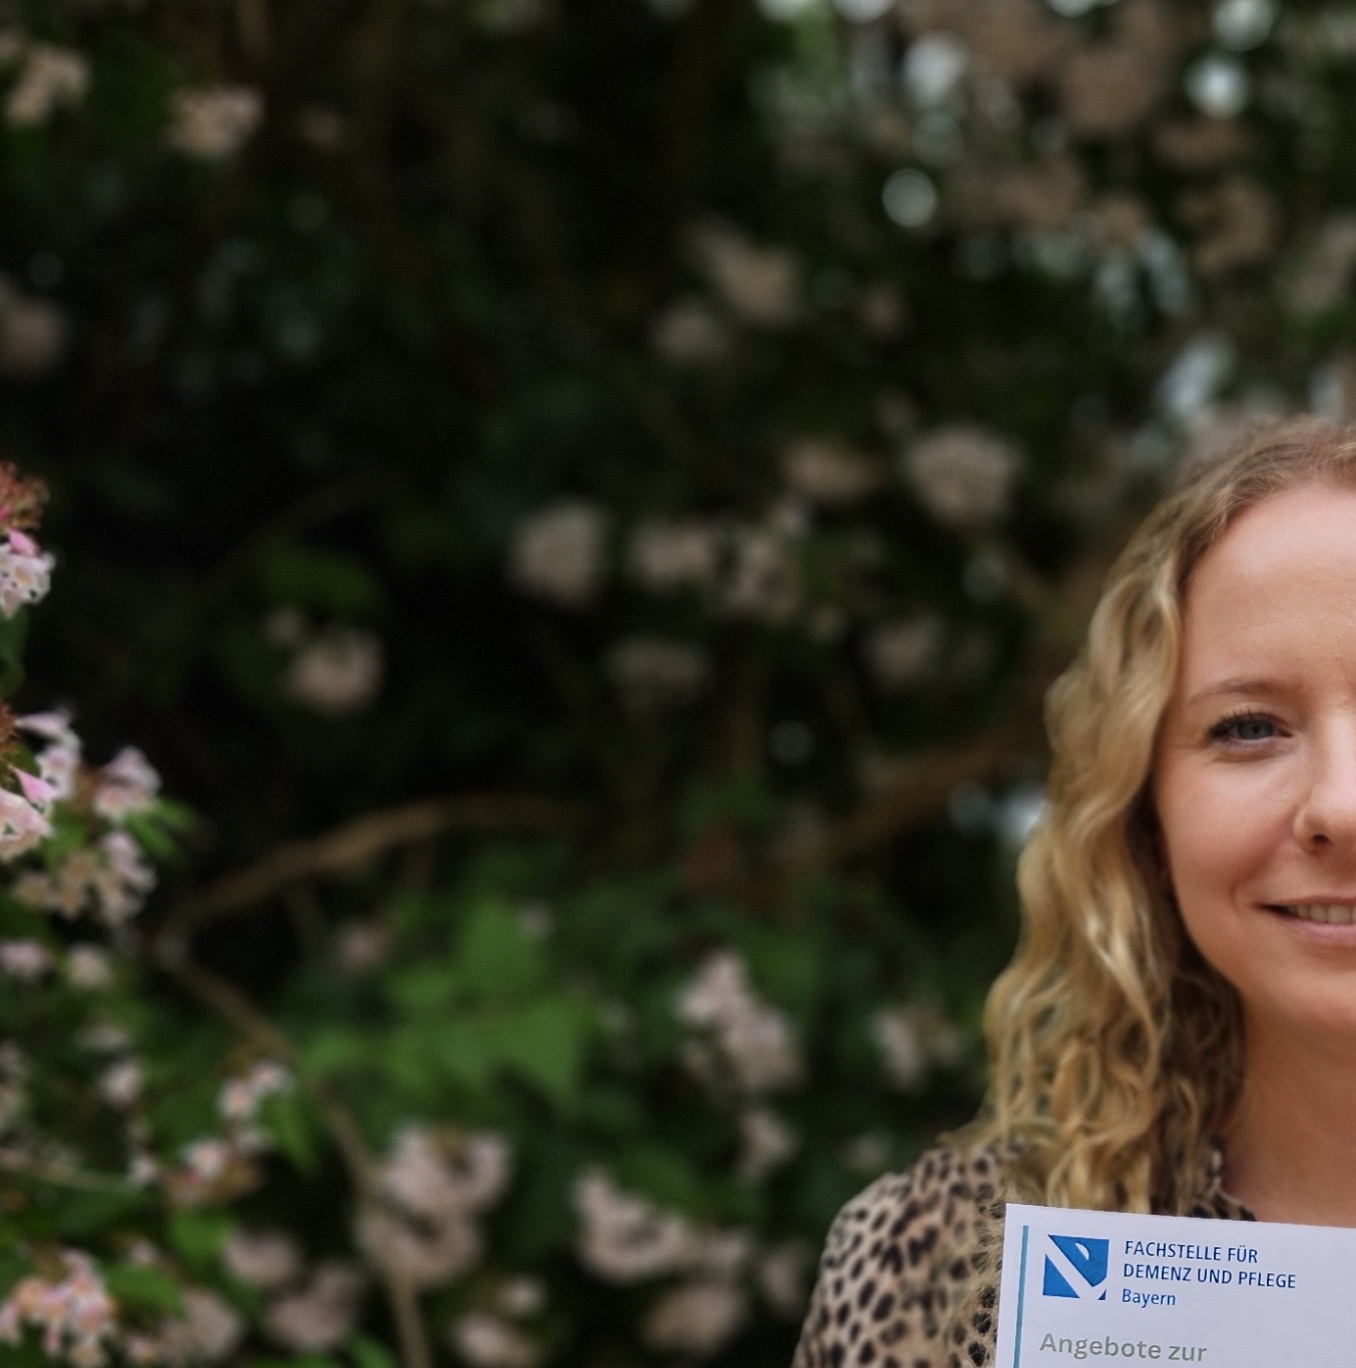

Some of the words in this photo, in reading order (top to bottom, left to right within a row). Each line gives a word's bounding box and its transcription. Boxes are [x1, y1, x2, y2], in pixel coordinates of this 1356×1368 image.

[1125, 1240, 1221, 1260] FACHSTELLE
[1227, 1246, 1257, 1263] FÜR
[1123, 1263, 1191, 1281] DEMENZ
[1197, 1268, 1232, 1283] UND
[1238, 1271, 1295, 1288] PFLEGE
[1122, 1288, 1175, 1308] Bayern
[1039, 1333, 1160, 1359] Angebote
[1168, 1345, 1207, 1361] zur
